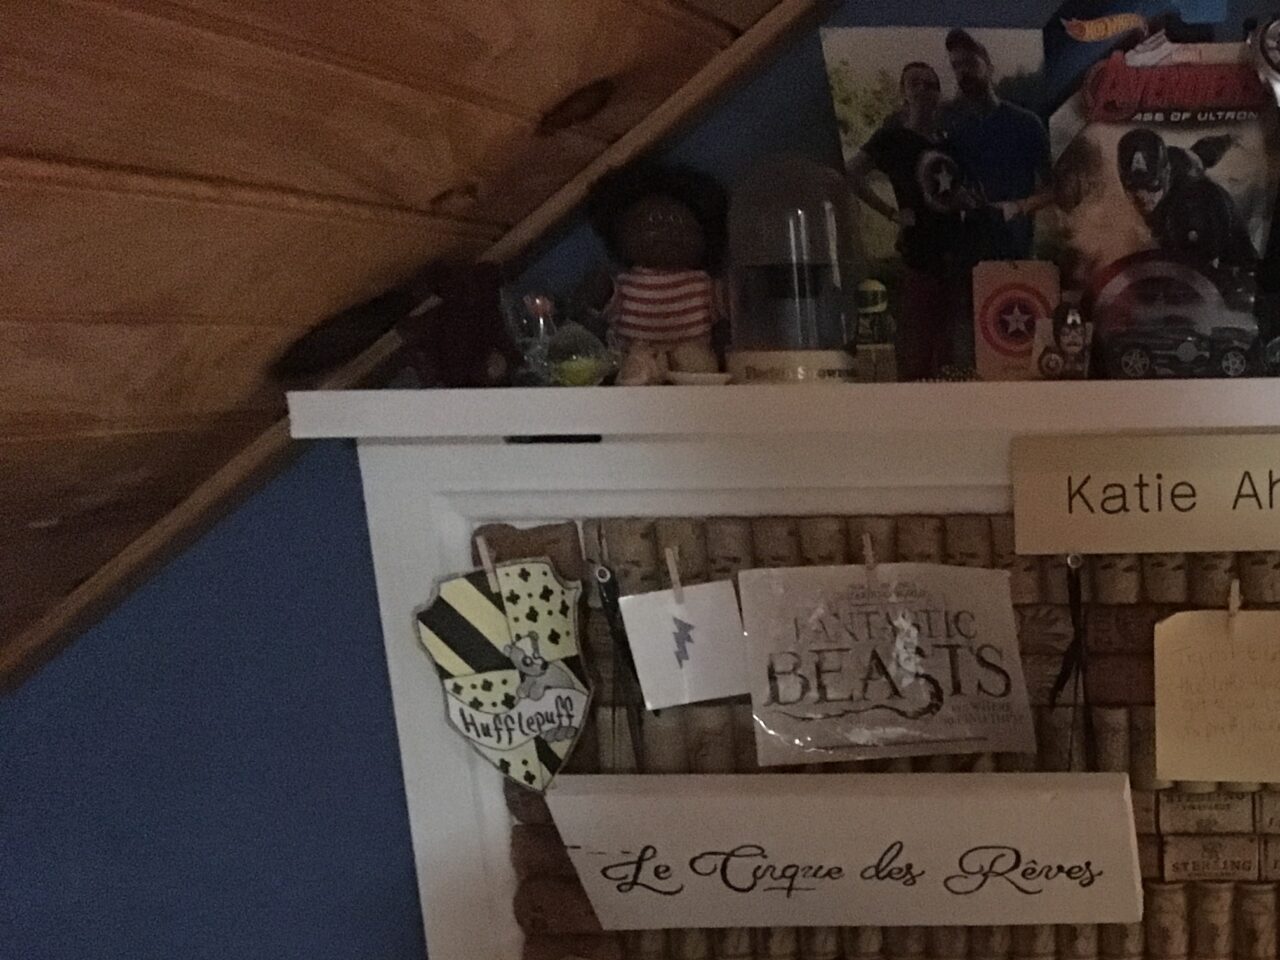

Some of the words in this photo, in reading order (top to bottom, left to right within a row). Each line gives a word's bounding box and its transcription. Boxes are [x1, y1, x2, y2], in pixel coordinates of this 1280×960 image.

[1170, 111, 1192, 121] OF
[1197, 109, 1260, 121] ULTRON
[1067, 473, 1197, 515] Katie
[461, 697, 579, 746] Hufflepuff
[600, 843, 686, 898] Le
[690, 842, 844, 899] Cirque
[860, 839, 927, 888] des
[944, 842, 1104, 897] Rêves
